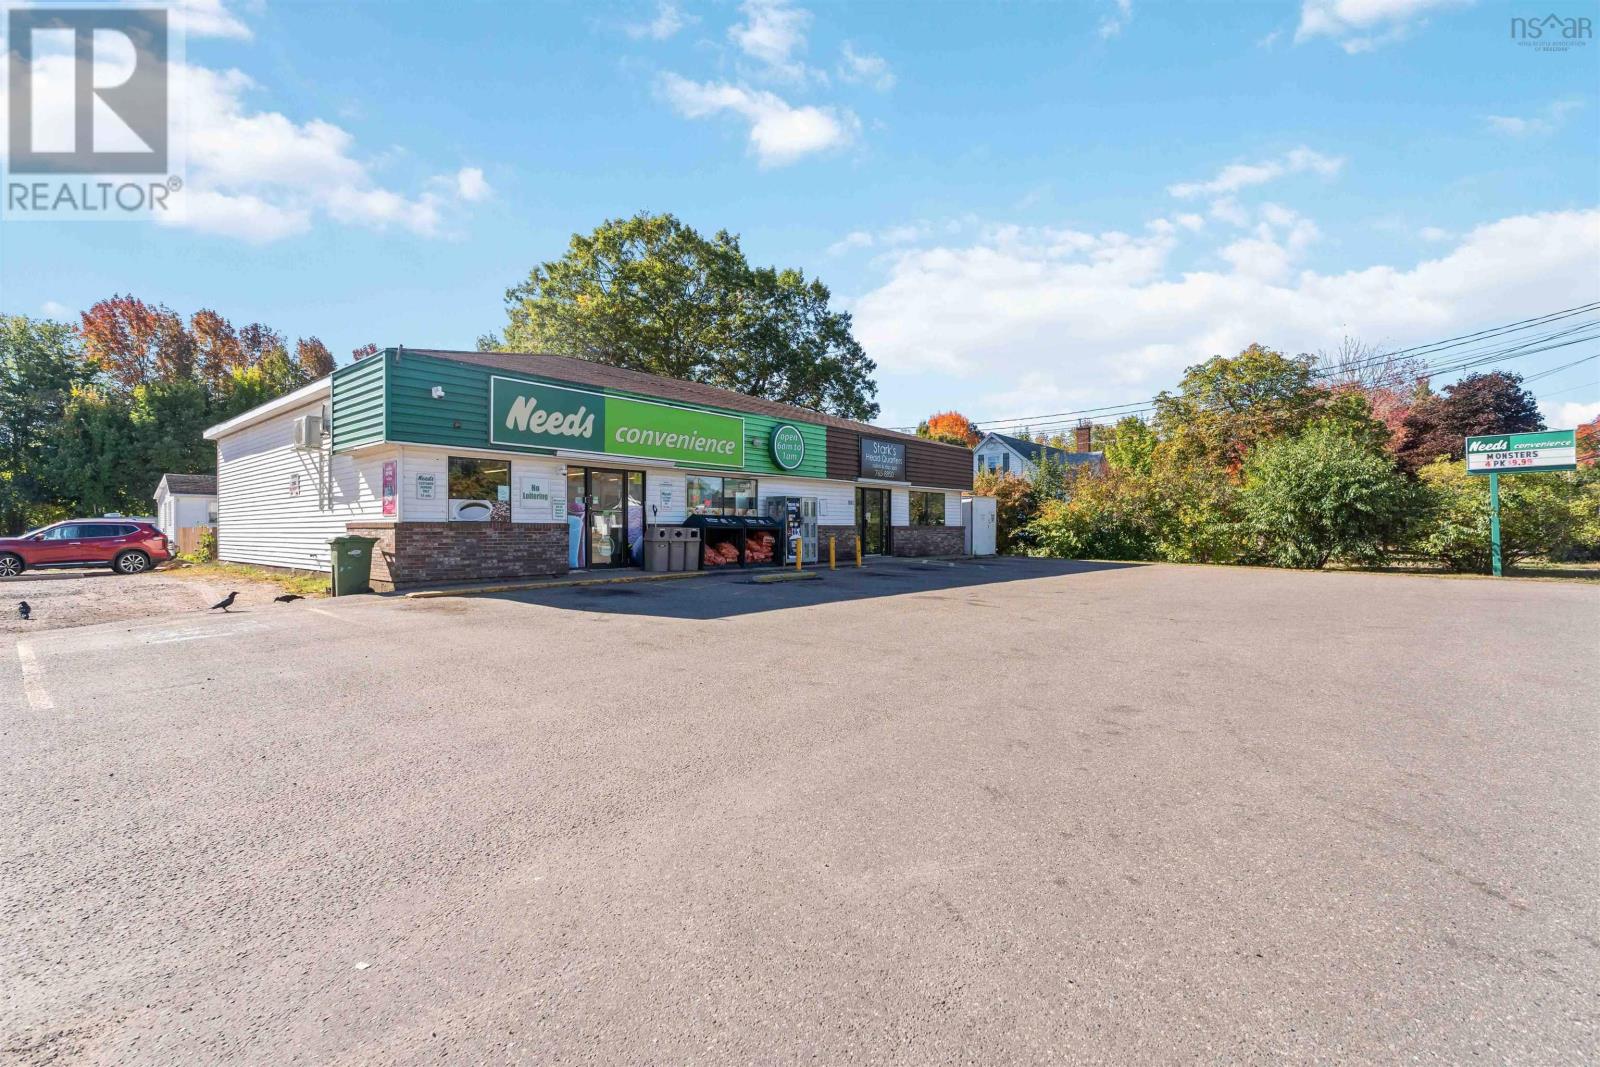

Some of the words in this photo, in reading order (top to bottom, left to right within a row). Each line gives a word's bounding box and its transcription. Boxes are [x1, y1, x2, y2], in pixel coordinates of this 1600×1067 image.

[505, 395, 595, 439] Needs
[615, 426, 736, 455] convenience
[780, 433, 798, 442] open
[777, 441, 793, 450] 6am
[873, 441, 896, 456] Stark's
[1469, 440, 1507, 451] Needs
[1515, 441, 1571, 449] convenience
[865, 453, 881, 462] Head
[881, 454, 903, 464] Quarters
[1487, 451, 1538, 460] MONSTERS
[531, 484, 540, 492] No
[522, 492, 548, 501] Loitering
